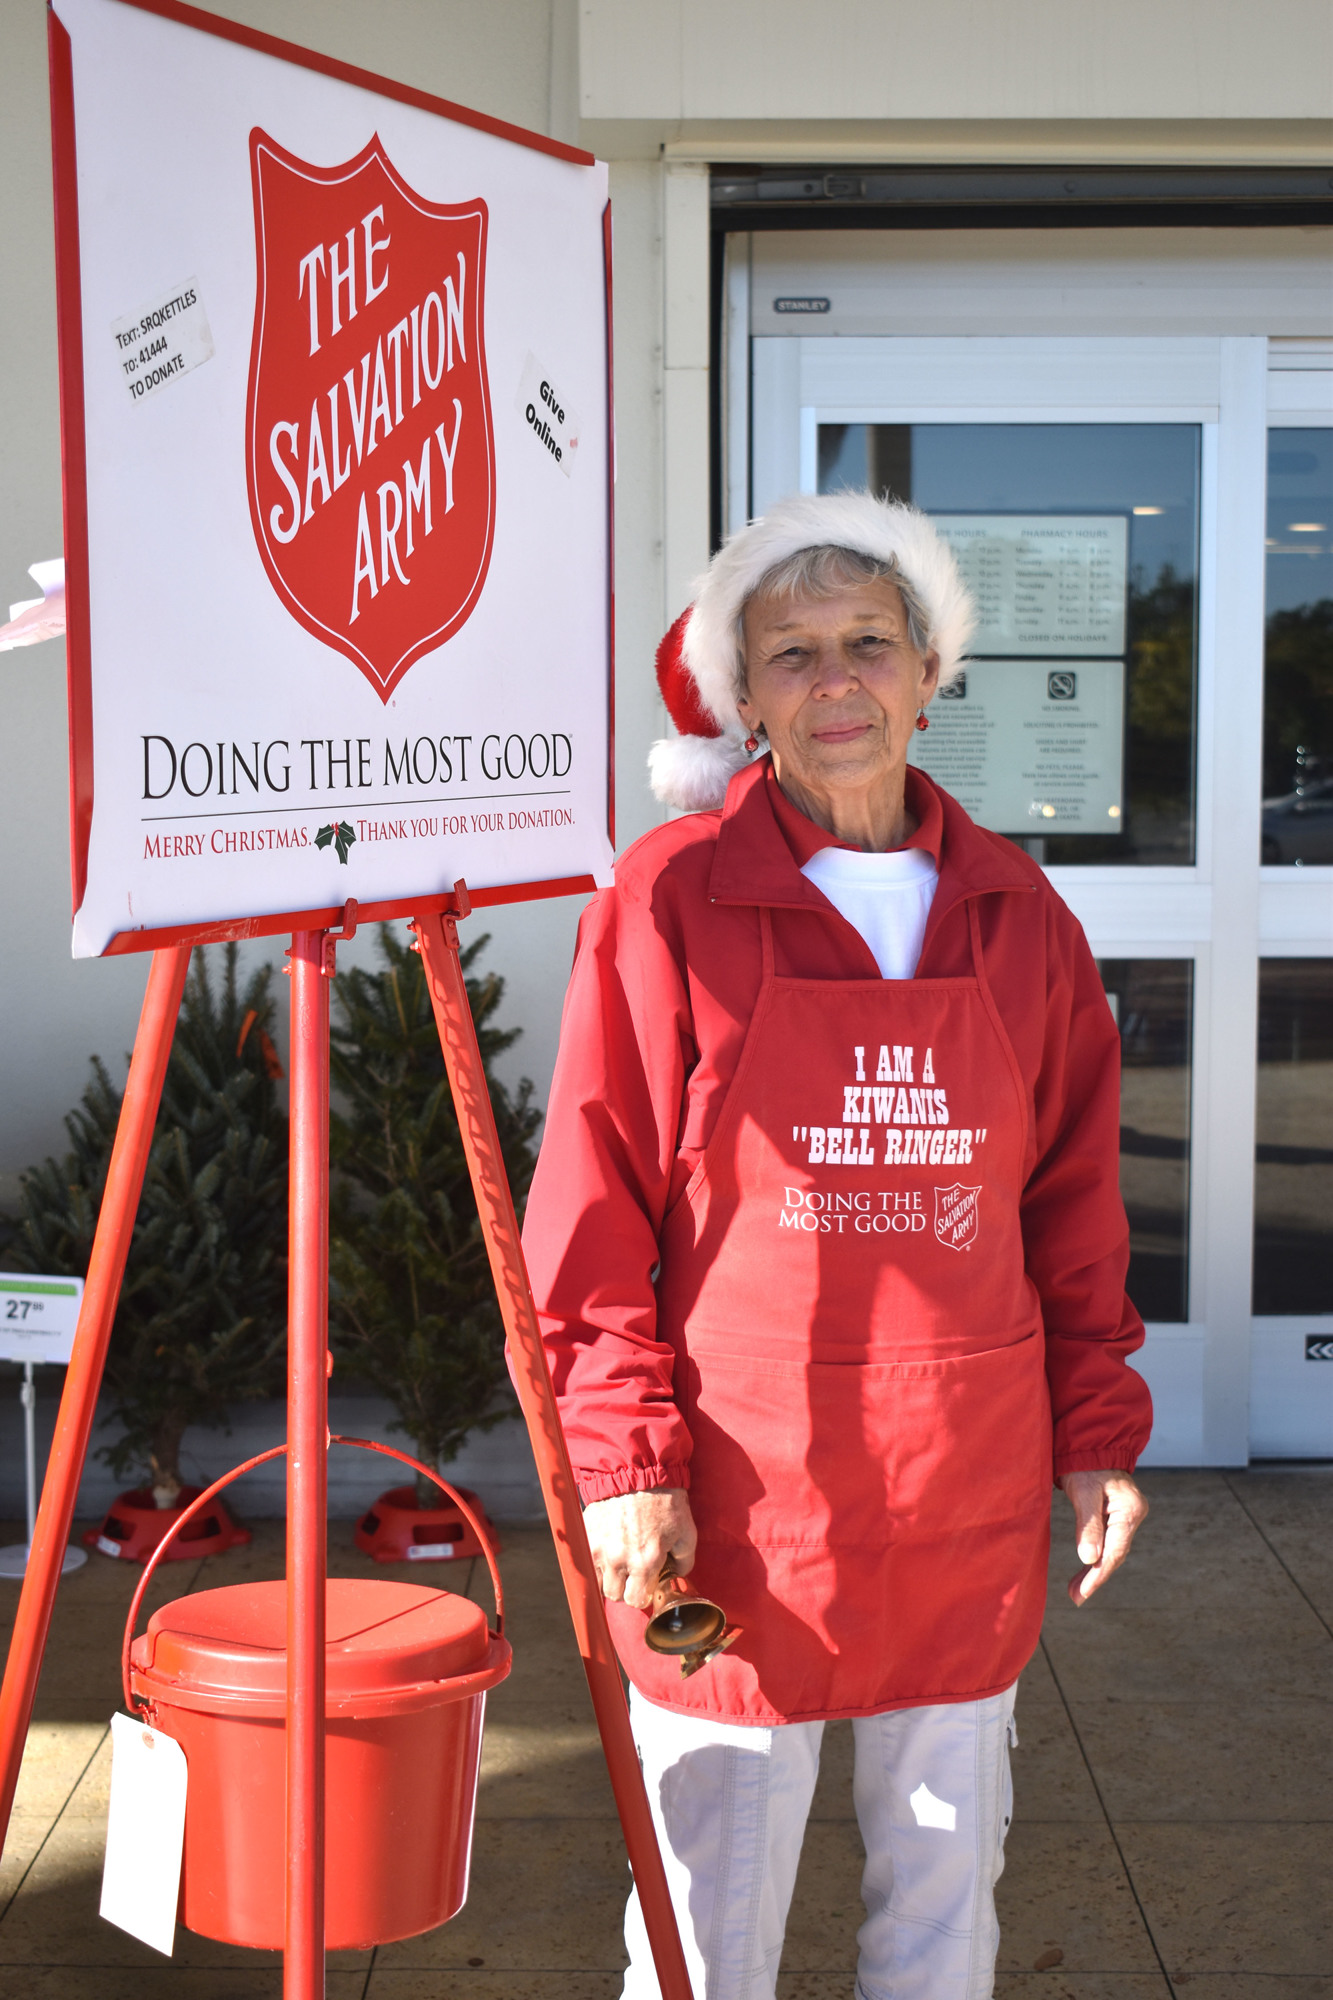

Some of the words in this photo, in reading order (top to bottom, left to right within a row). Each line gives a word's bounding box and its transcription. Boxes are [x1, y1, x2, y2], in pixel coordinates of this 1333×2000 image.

[299, 204, 391, 357] THE
[116, 324, 140, 350] TEXT:
[141, 288, 198, 334] SRQKETTLES
[777, 299, 827, 311] STANLEY
[123, 354, 138, 375] TO:
[139, 336, 168, 364] 41444
[130, 380, 145, 399] TO
[145, 353, 185, 394] DONATE
[270, 252, 467, 543] SALVATION
[539, 380, 565, 424] Give
[525, 404, 563, 462] Online
[349, 398, 462, 625] ARMY
[140, 735, 292, 799] DOING
[301, 739, 373, 790] THE
[383, 736, 473, 786] MOST
[481, 733, 572, 781] GOOD
[143, 833, 205, 860] MERRY
[211, 826, 312, 853] CHRISTMAS.
[357, 819, 409, 842] THANK
[410, 817, 438, 837] YOU
[443, 815, 468, 835] FOR
[469, 813, 505, 833] YOUR
[508, 808, 575, 831] DONATION.
[854, 1046, 866, 1081] I
[876, 1045, 914, 1083] AM
[922, 1047, 936, 1084] A
[842, 1086, 950, 1125] KIWANIS
[792, 1126, 874, 1165] "BELL
[884, 1128, 987, 1165] RINGER"
[784, 1186, 871, 1211] DOING
[878, 1191, 922, 1211] THE
[937, 1190, 977, 1235] SALVATION
[941, 1188, 961, 1212] THE
[778, 1209, 849, 1233] MOST
[854, 1213, 927, 1233] GOOD
[951, 1211, 975, 1244] ARMY
